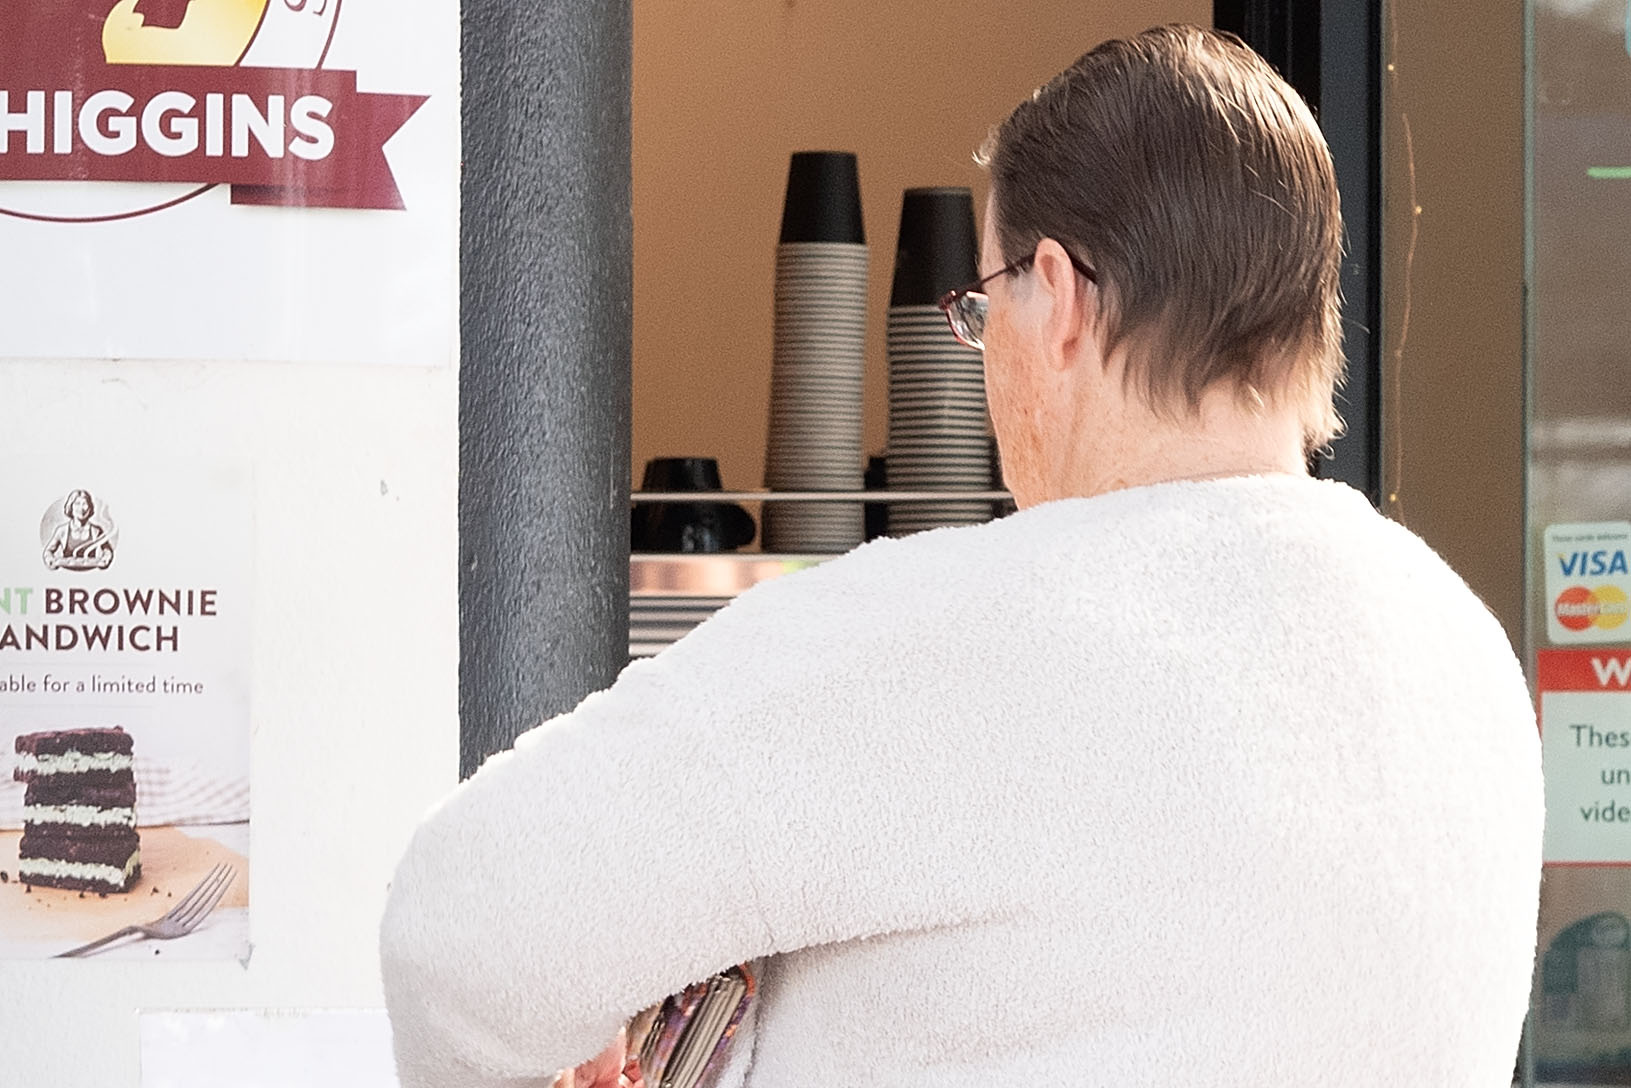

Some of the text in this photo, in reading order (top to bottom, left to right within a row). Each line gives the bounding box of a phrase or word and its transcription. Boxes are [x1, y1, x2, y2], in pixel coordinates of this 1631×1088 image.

[1558, 549, 1628, 576] VISA
[45, 588, 218, 617] BROWNIE
[43, 674, 70, 692] for
[76, 679, 86, 692] a
[92, 675, 157, 694] limited
[163, 675, 204, 694] time
